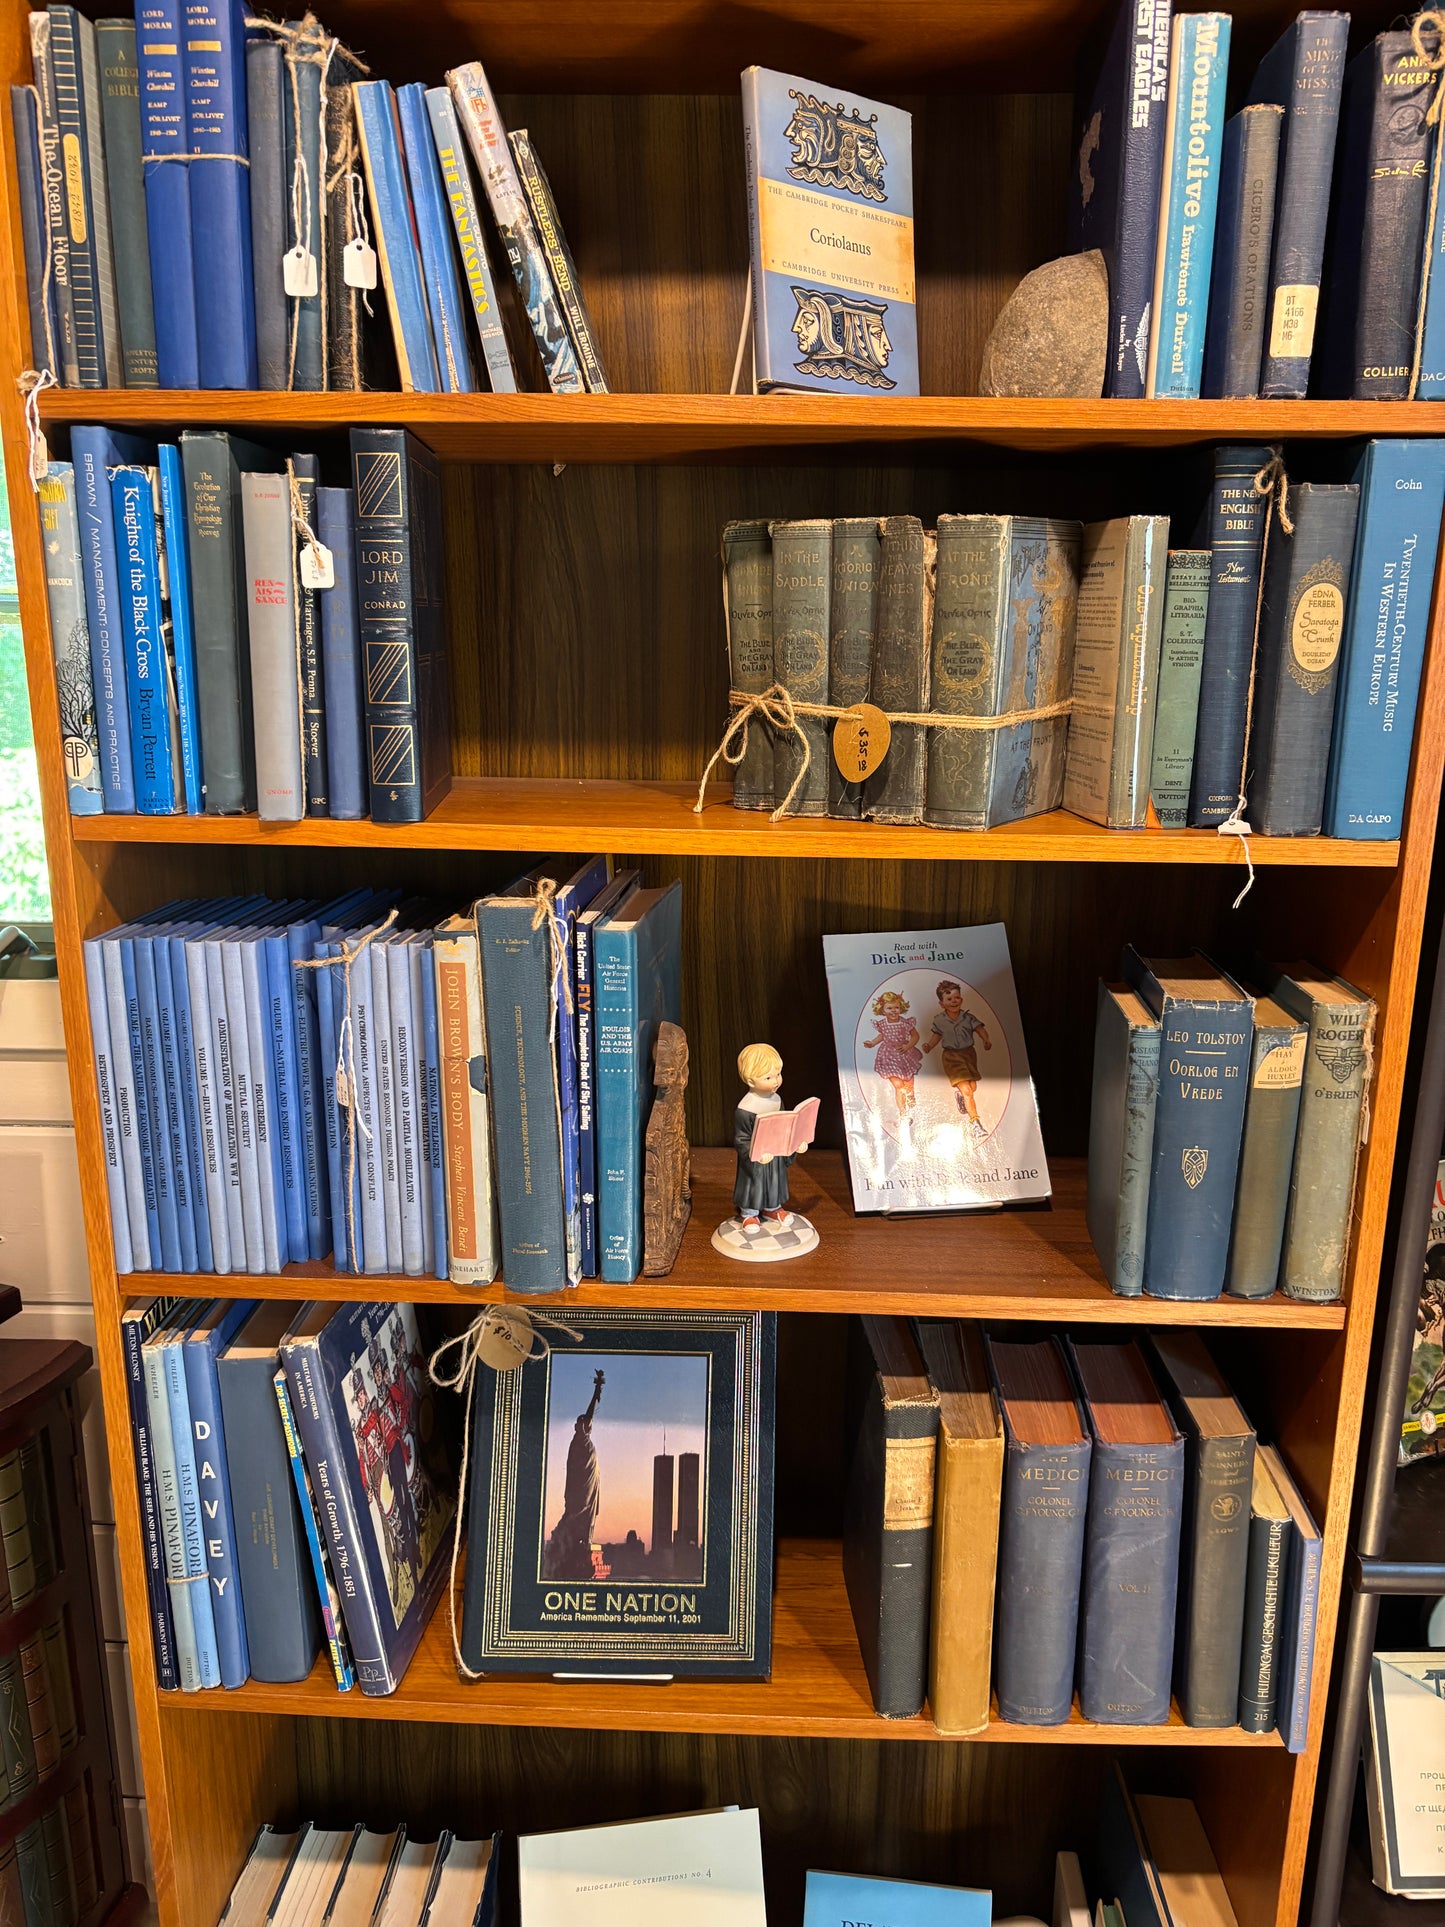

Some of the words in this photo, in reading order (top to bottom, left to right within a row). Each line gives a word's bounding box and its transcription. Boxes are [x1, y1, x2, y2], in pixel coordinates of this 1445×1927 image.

[142, 10, 164, 18] LORD
[187, 6, 208, 14] LORD
[188, 18, 217, 26] MORAN
[1136, 0, 1154, 40] RST
[143, 22, 173, 30] MORAN
[1151, 0, 1171, 102] MERICA'S
[1132, 43, 1153, 128] EAGLES
[1383, 72, 1437, 86] VICKERS
[1183, 20, 1220, 217] Mountolive
[43, 124, 60, 162] The
[47, 166, 63, 228] Ocean
[768, 184, 784, 196] THE
[785, 190, 829, 208] CAMBRIDGE
[831, 202, 859, 217] POCKET
[861, 210, 908, 229] SHAKESPEARE
[1248, 179, 1264, 249] CICERO'S
[440, 148, 461, 187] THE
[451, 191, 491, 315] FANTASTICS
[809, 227, 872, 256] Coriolanus
[53, 236, 70, 287] Floor
[529, 176, 558, 251] RUSTLERS'
[552, 255, 571, 292] BEND
[569, 306, 582, 330] WILL
[577, 331, 597, 369] ERMINE
[1177, 225, 1195, 307] Lawrence
[781, 260, 827, 278] CAMBRIDGE
[831, 272, 875, 290] UNIVERSITY
[878, 284, 900, 295] PRESS
[1242, 253, 1259, 331] ORATIONS
[1285, 307, 1304, 317] 4166
[1171, 312, 1188, 374] Durrell
[1363, 366, 1410, 378] COLLIER
[1395, 478, 1423, 490] Cohn
[123, 486, 142, 547] Knights
[1219, 503, 1262, 515] ENGLISH
[1225, 519, 1254, 530] BIBLE
[128, 548, 145, 565] of
[361, 551, 404, 565] LORD
[795, 551, 820, 565] THE
[130, 567, 147, 591] the
[364, 570, 400, 584] JIM
[775, 574, 825, 590] SADDLE
[939, 572, 992, 586] FRONT
[363, 600, 407, 610] CONRAD
[1308, 599, 1336, 608] FERBER
[1312, 590, 1334, 599] EDNA
[132, 595, 150, 636] Black
[1173, 604, 1204, 612] GRAPHIA
[1299, 612, 1339, 629] Saratoga
[1374, 583, 1395, 650] WESTERN
[1166, 637, 1204, 645] COLERIDGE
[1302, 629, 1335, 644] Trunk
[135, 638, 152, 679] Cross
[1368, 653, 1386, 706] EUROPE
[139, 688, 154, 732] Bryan
[1382, 690, 1399, 732] MUSIC
[310, 722, 320, 758] Stoever
[142, 734, 158, 780] Perrett
[1349, 814, 1364, 823] DA
[1365, 814, 1392, 823] CAPO
[576, 931, 586, 949] Rick
[893, 942, 917, 952] Read
[918, 941, 938, 950] with
[576, 950, 588, 981] Carrier
[871, 951, 907, 965] Dick
[908, 953, 926, 962] and
[927, 950, 964, 963] Jane
[445, 969, 460, 1011] JOHN
[577, 983, 591, 1012] FLY
[578, 1013, 589, 1026] The
[579, 1026, 590, 1061] Complete
[1166, 1031, 1189, 1043] LEO
[1196, 1032, 1246, 1044] TOLSTOY
[1316, 1028, 1364, 1041] ROGER
[398, 1026, 409, 1088] RECONVERSION
[450, 1018, 463, 1085] BROWN'S
[579, 1061, 590, 1079] Book
[1169, 1059, 1218, 1078] OORLOG
[1224, 1065, 1239, 1077] EN
[1267, 1065, 1298, 1073] ALDOUS
[1267, 1072, 1297, 1080] HUXLEY
[237, 1074, 248, 1110] MUTUAL
[580, 1080, 590, 1088] of
[580, 1089, 591, 1102] Sky
[1180, 1082, 1223, 1100] VREDE
[1314, 1087, 1360, 1099] O'BRIEN
[119, 1086, 133, 1137] PRODUCTION
[401, 1089, 410, 1110] AND
[451, 1091, 464, 1130] BODY
[255, 1083, 267, 1143] PROCUREMENT
[325, 1076, 339, 1150] TRANSPORTATION
[580, 1102, 591, 1131] Sailing
[240, 1110, 251, 1149] SECURITY
[403, 1110, 412, 1145] PARTIAL
[404, 1147, 415, 1203] MOBILIZATION
[452, 1144, 466, 1183] Stephen
[455, 1185, 467, 1222] Vincent
[1292, 1286, 1336, 1295] WINSTON
[128, 1324, 138, 1351] MILTON
[131, 1351, 141, 1382] KLONSKY
[294, 1371, 301, 1380] IN
[296, 1379, 308, 1409] AMERICA
[301, 1357, 312, 1387] MILITARY
[308, 1387, 320, 1420] UNIFORMS
[317, 1459, 330, 1488] Years
[1105, 1468, 1175, 1482] MEDICI
[139, 1427, 149, 1455] WILLIAM
[145, 1481, 153, 1495] THE
[152, 1545, 160, 1570] VISIONS
[323, 1488, 335, 1501] of
[1116, 1497, 1162, 1506] COLONEL
[150, 1363, 160, 1400] WHEELER
[186, 1656, 194, 1684] DUTTON
[170, 1358, 179, 1395] WHEELER
[202, 1651, 211, 1678] DUTTON
[326, 1502, 344, 1543] Growth,
[544, 1591, 596, 1612] ONE
[605, 1592, 697, 1614] NATION
[157, 1612, 168, 1645] HARMONY
[540, 1612, 573, 1623] America
[575, 1612, 622, 1623] Remembers
[623, 1612, 667, 1624] September
[668, 1613, 681, 1625] 11,
[682, 1614, 702, 1624] 2001
[161, 1644, 170, 1666] BOOKS
[1106, 1703, 1144, 1712] DUTTON
[1254, 1713, 1268, 1721] 215
[1415, 1805, 1426, 1813] ОТ
[575, 1880, 630, 1893] BIBLIOGRAPHIC
[632, 1873, 688, 1886] CONTRIBUTIONS
[706, 1868, 712, 1879] 4
